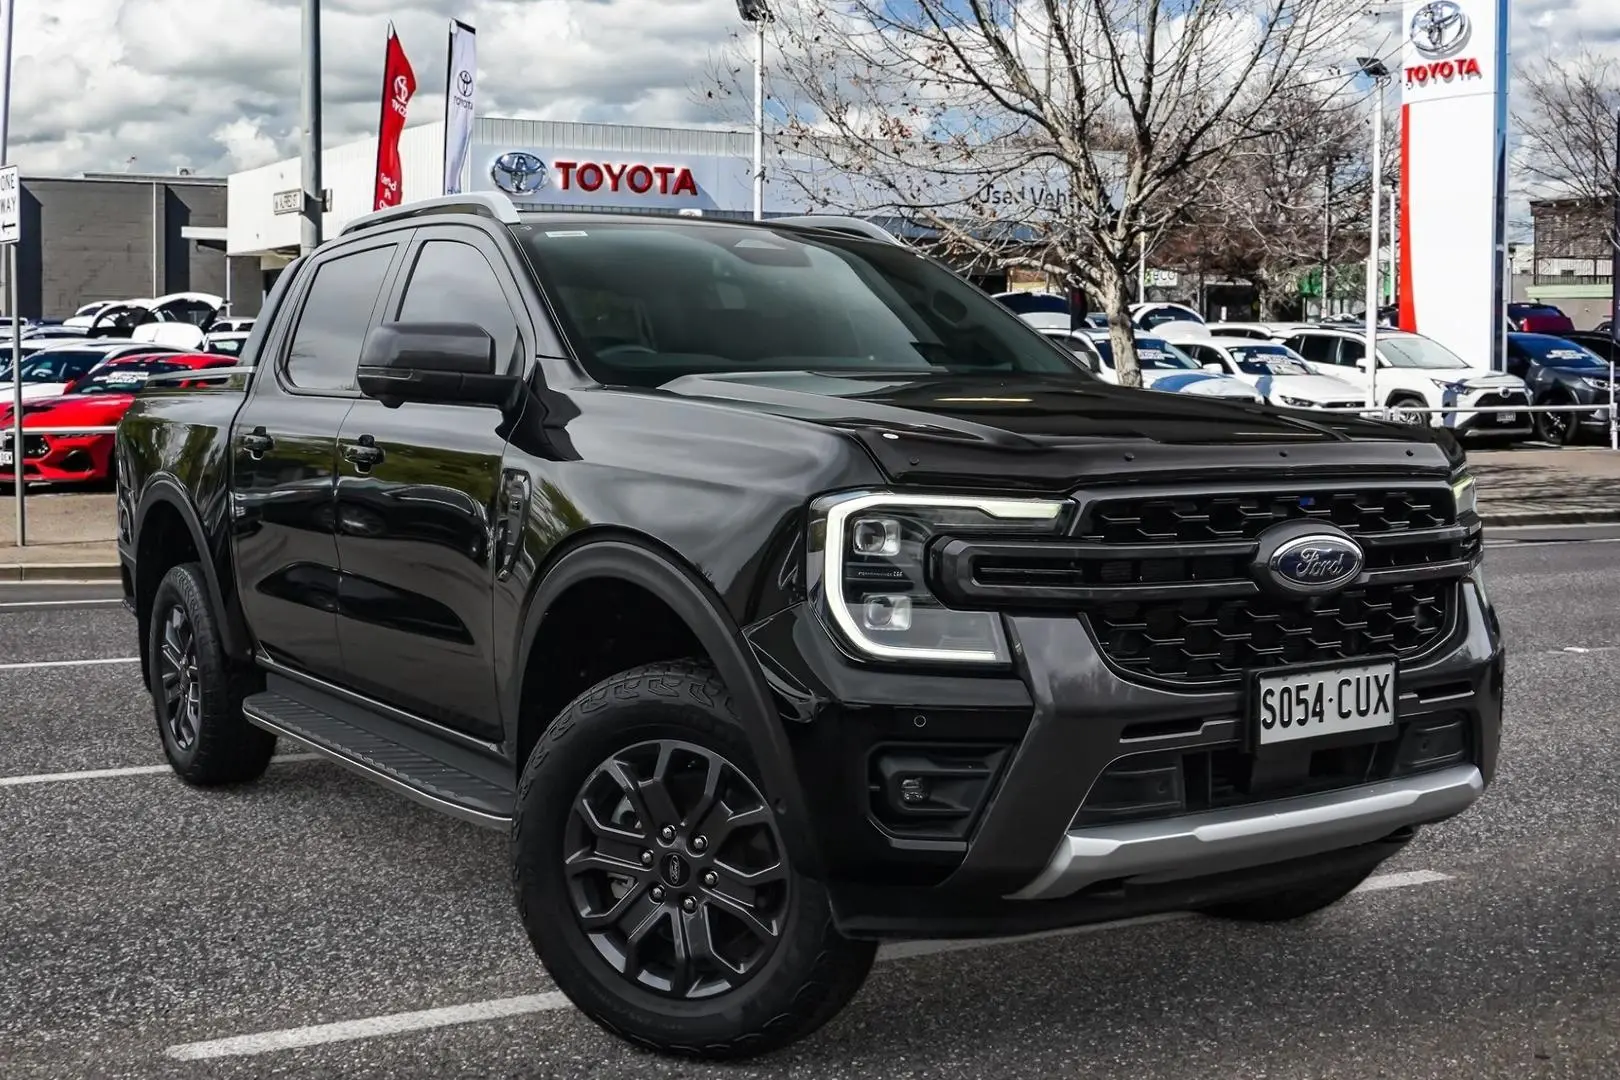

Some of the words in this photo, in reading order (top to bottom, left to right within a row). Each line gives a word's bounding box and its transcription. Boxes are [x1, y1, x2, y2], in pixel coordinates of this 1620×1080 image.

[1404, 58, 1481, 83] TOYOTA
[453, 96, 473, 110] TOYOTA
[1, 173, 15, 191] ONE
[555, 161, 698, 196] TOYOTA
[0, 197, 16, 215] WAY
[1296, 547, 1345, 578] Ford
